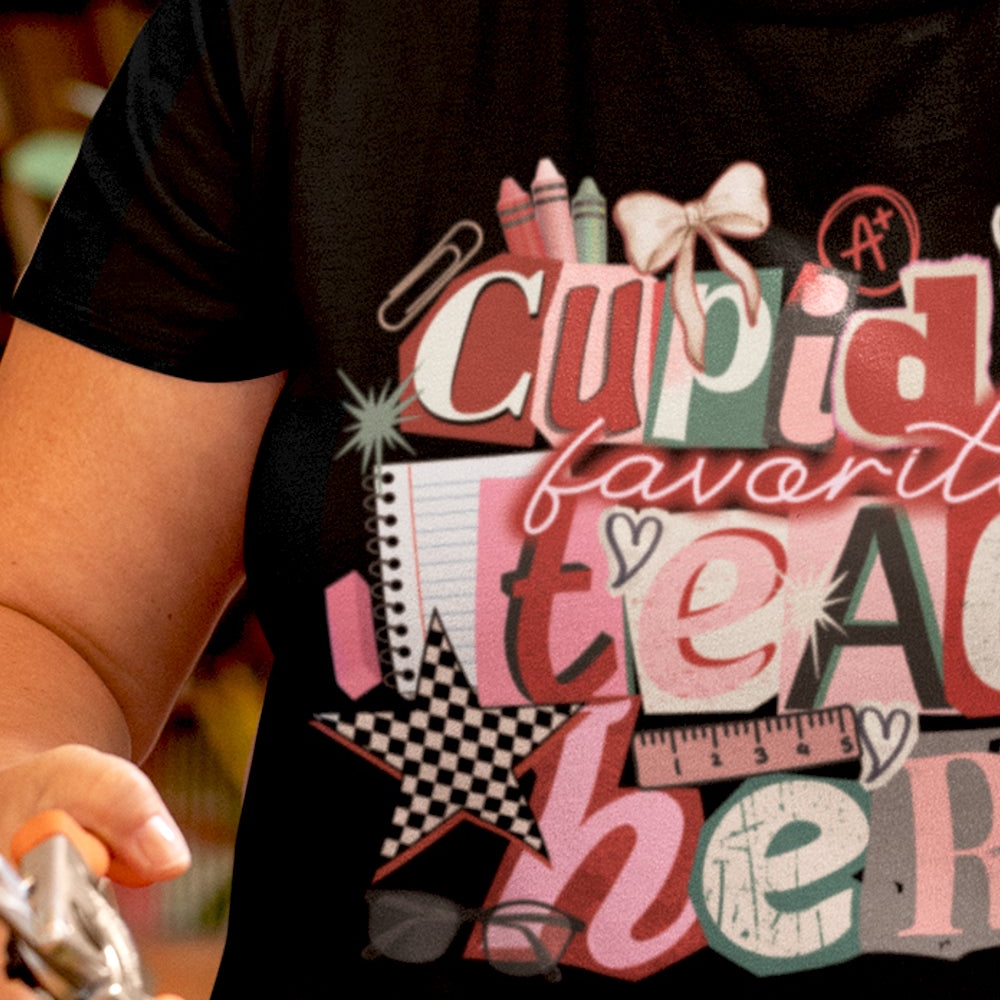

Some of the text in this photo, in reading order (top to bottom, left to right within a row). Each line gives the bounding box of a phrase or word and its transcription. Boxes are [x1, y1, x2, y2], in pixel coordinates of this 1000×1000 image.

[840, 206, 894, 271] A+
[711, 752, 723, 767] 2
[753, 746, 769, 765] 3
[840, 735, 854, 752] 5
